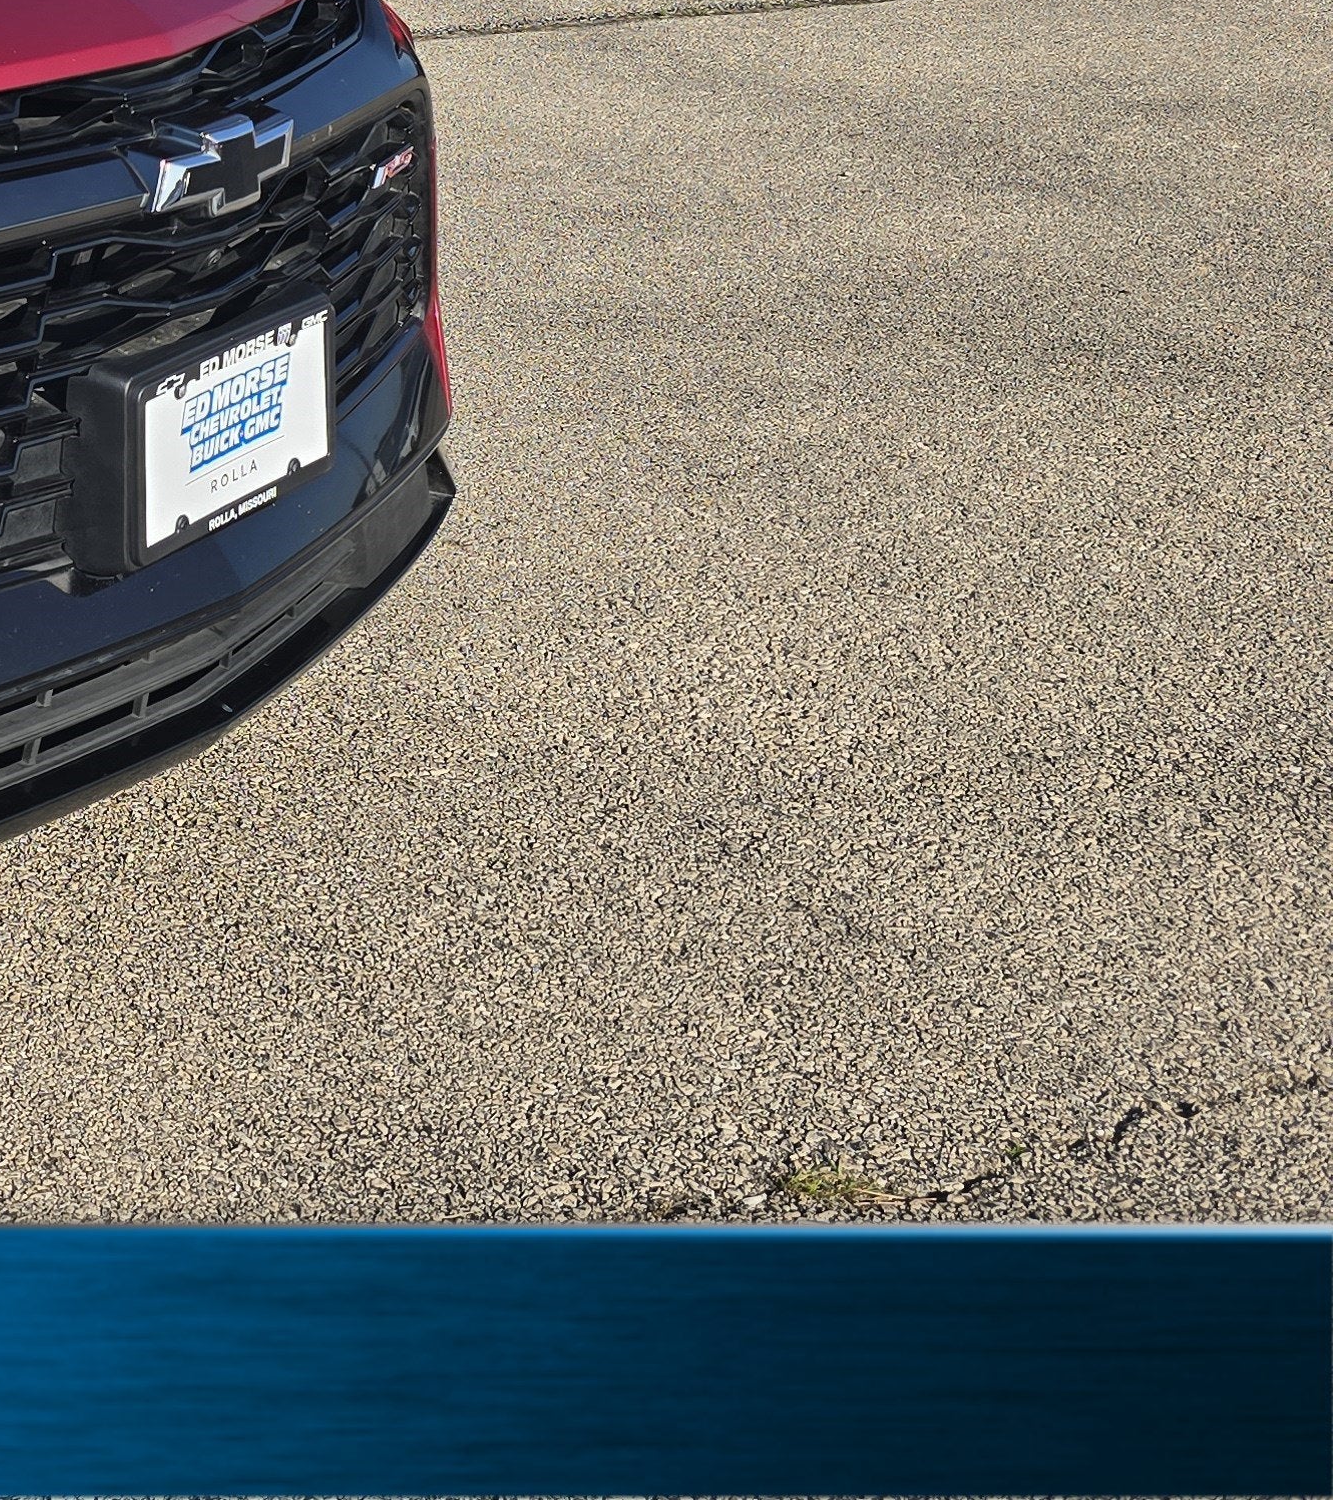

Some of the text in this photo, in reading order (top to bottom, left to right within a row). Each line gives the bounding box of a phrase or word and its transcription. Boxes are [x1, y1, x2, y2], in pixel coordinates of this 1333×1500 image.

[302, 310, 329, 330] GMC
[199, 329, 275, 381] ED MORSE
[182, 353, 290, 432] ED MORSE
[190, 386, 282, 444] CHEVROLET
[190, 404, 282, 471] BUICK GMC
[210, 459, 258, 493] ROLLA
[208, 486, 277, 531] ROLLA, MISSOURI
